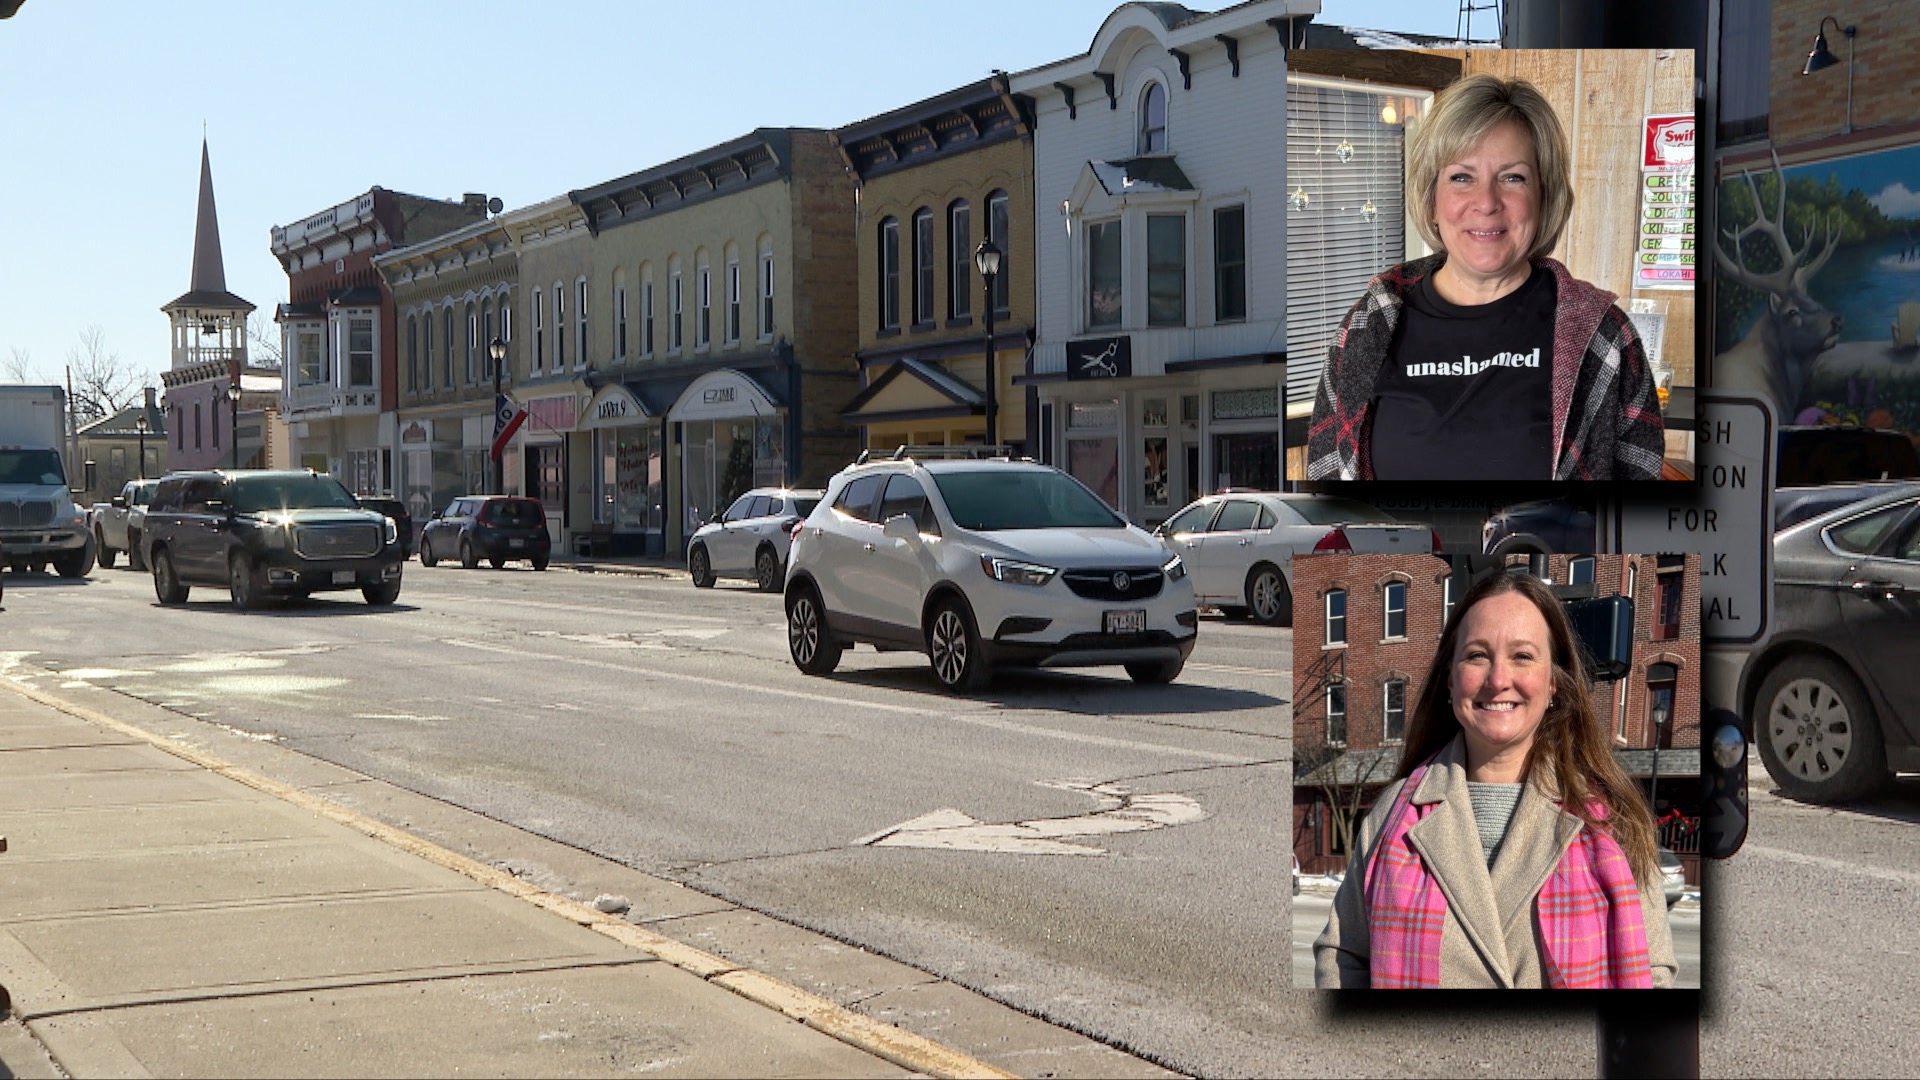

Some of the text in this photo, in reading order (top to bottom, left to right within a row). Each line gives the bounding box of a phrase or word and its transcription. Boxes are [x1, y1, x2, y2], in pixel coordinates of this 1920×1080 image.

[1657, 270, 1691, 279] LOKAHI
[1406, 348, 1540, 377] unashamed
[1667, 508, 1718, 532] FOR
